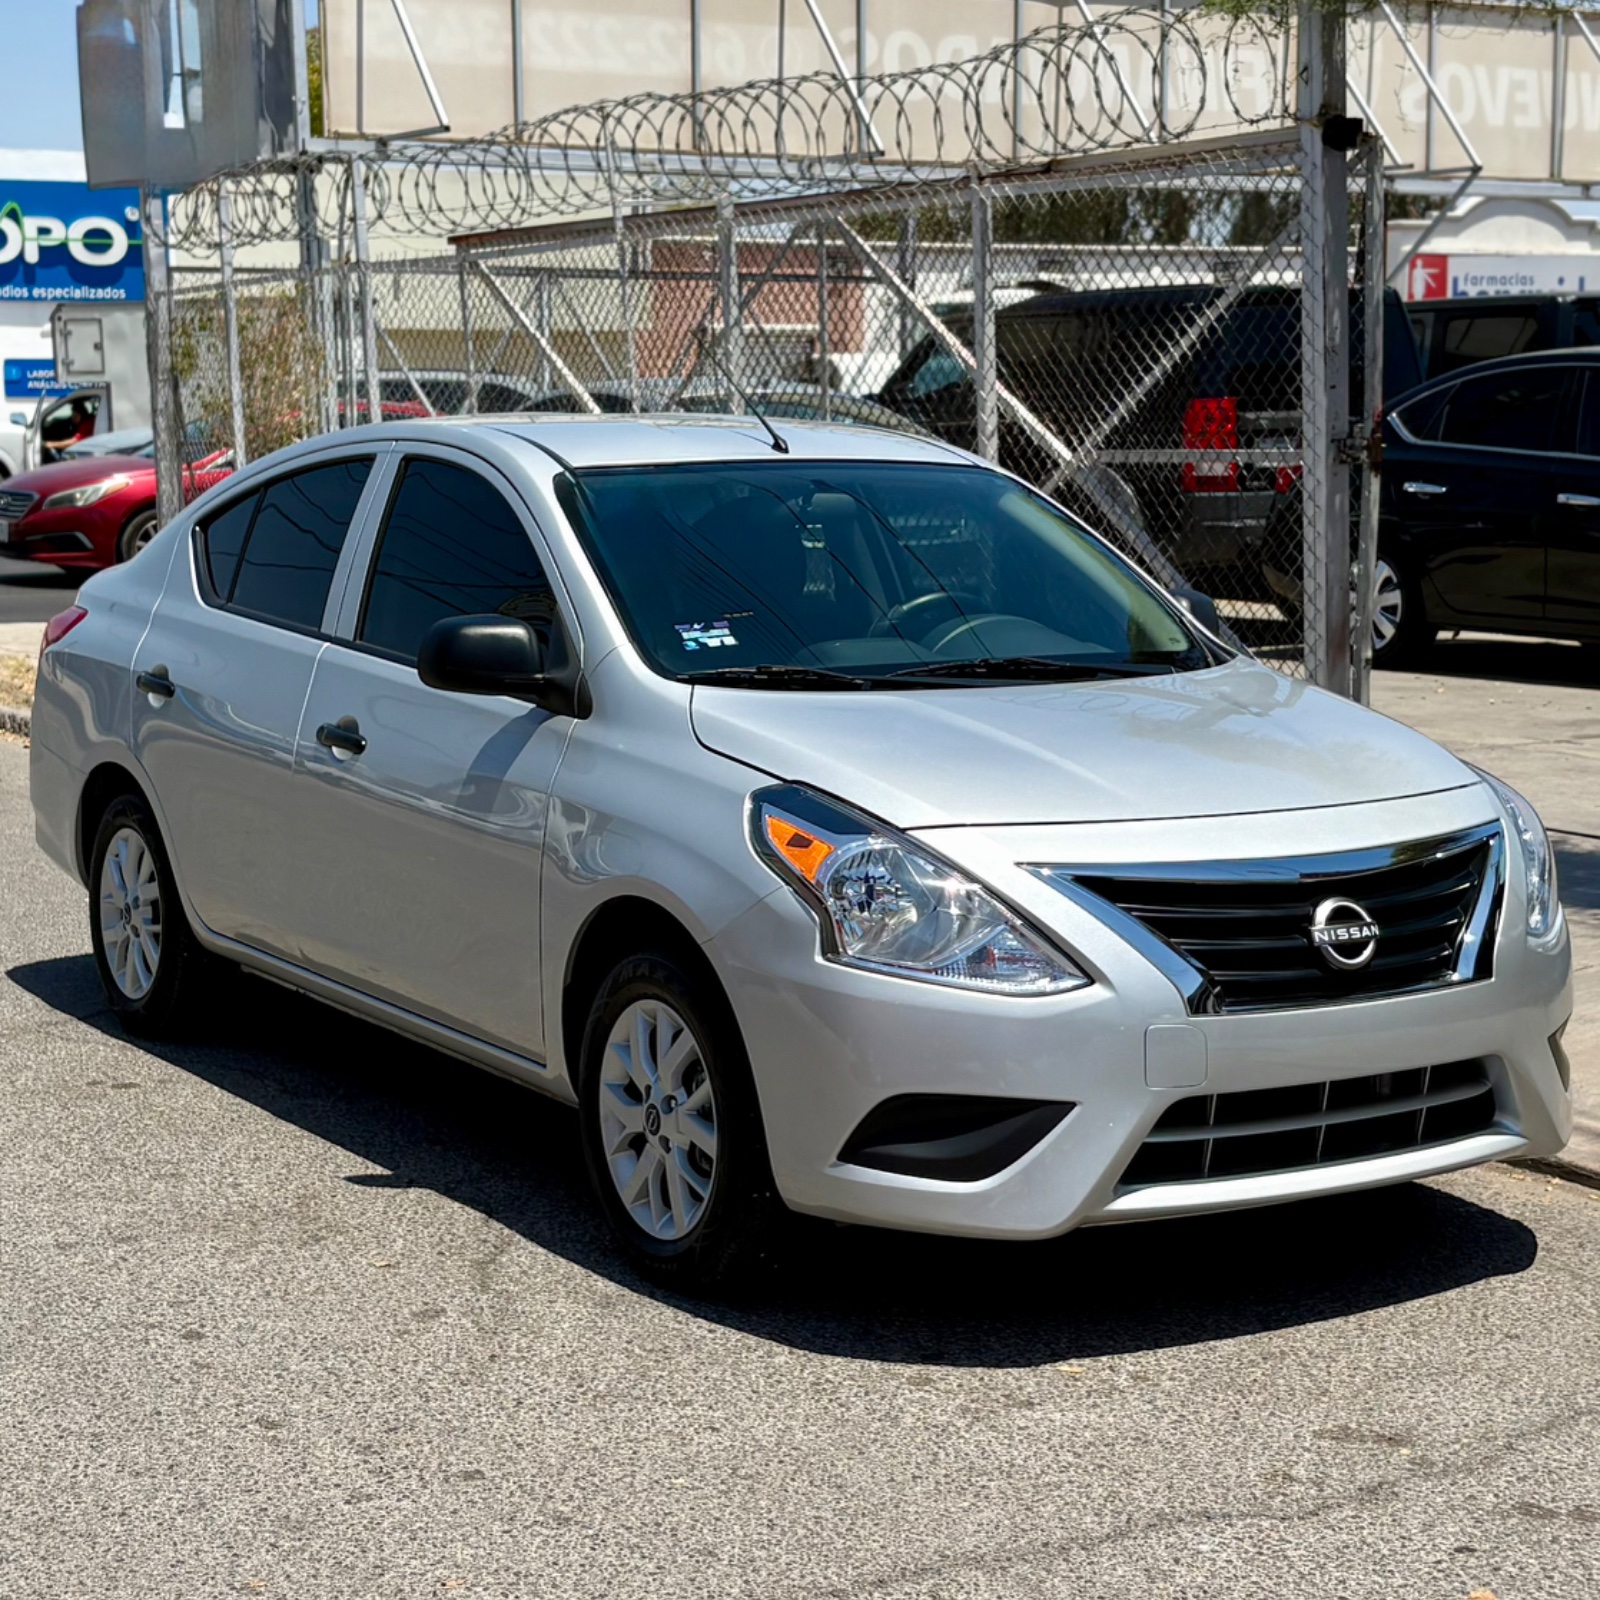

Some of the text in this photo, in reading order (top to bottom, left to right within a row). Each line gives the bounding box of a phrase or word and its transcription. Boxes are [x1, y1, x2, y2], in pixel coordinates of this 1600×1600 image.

[1464, 273, 1535, 287] farmacias
[0, 285, 126, 300] dios especializados
[1314, 924, 1379, 942] NISSAN
